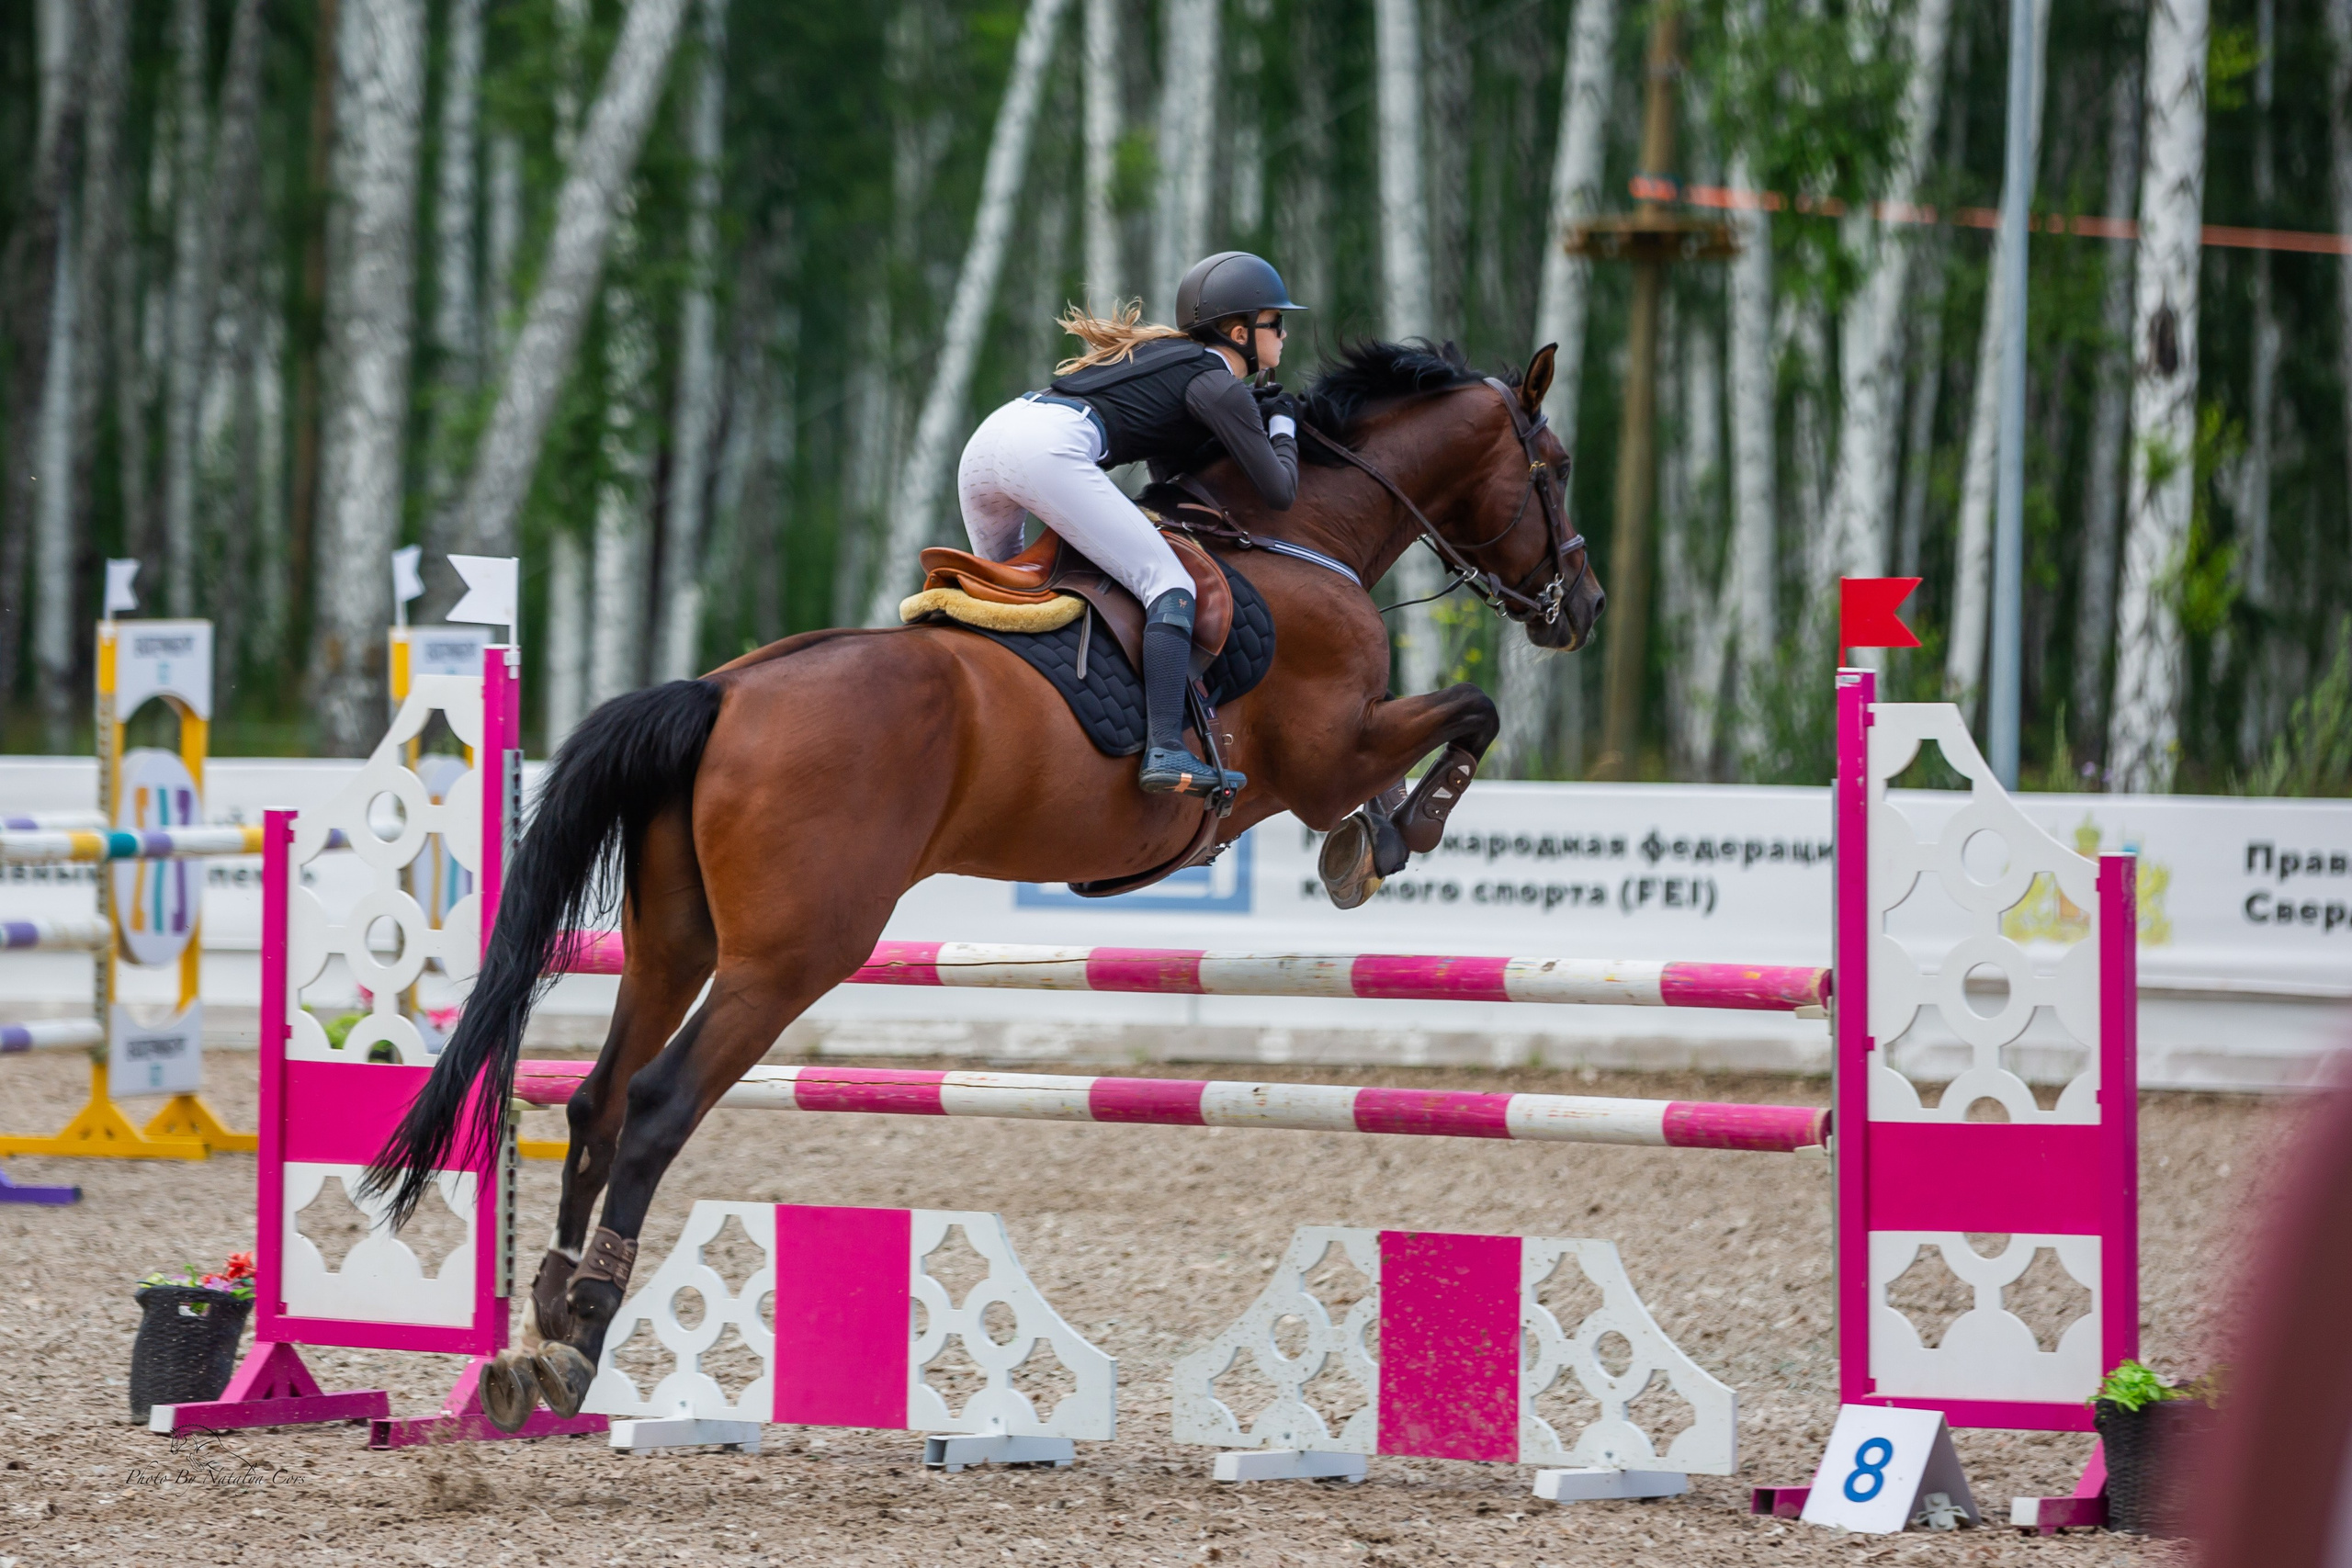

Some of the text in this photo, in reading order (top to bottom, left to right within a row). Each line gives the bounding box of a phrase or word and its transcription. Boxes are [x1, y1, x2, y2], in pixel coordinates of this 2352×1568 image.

[1302, 825, 1833, 867] народная федераци
[2245, 842, 2351, 882] Прав
[1473, 880, 1606, 912] спорта
[1621, 876, 1717, 915] (FEI)
[2245, 891, 2351, 932] Свер
[1843, 1437, 1894, 1503] 8
